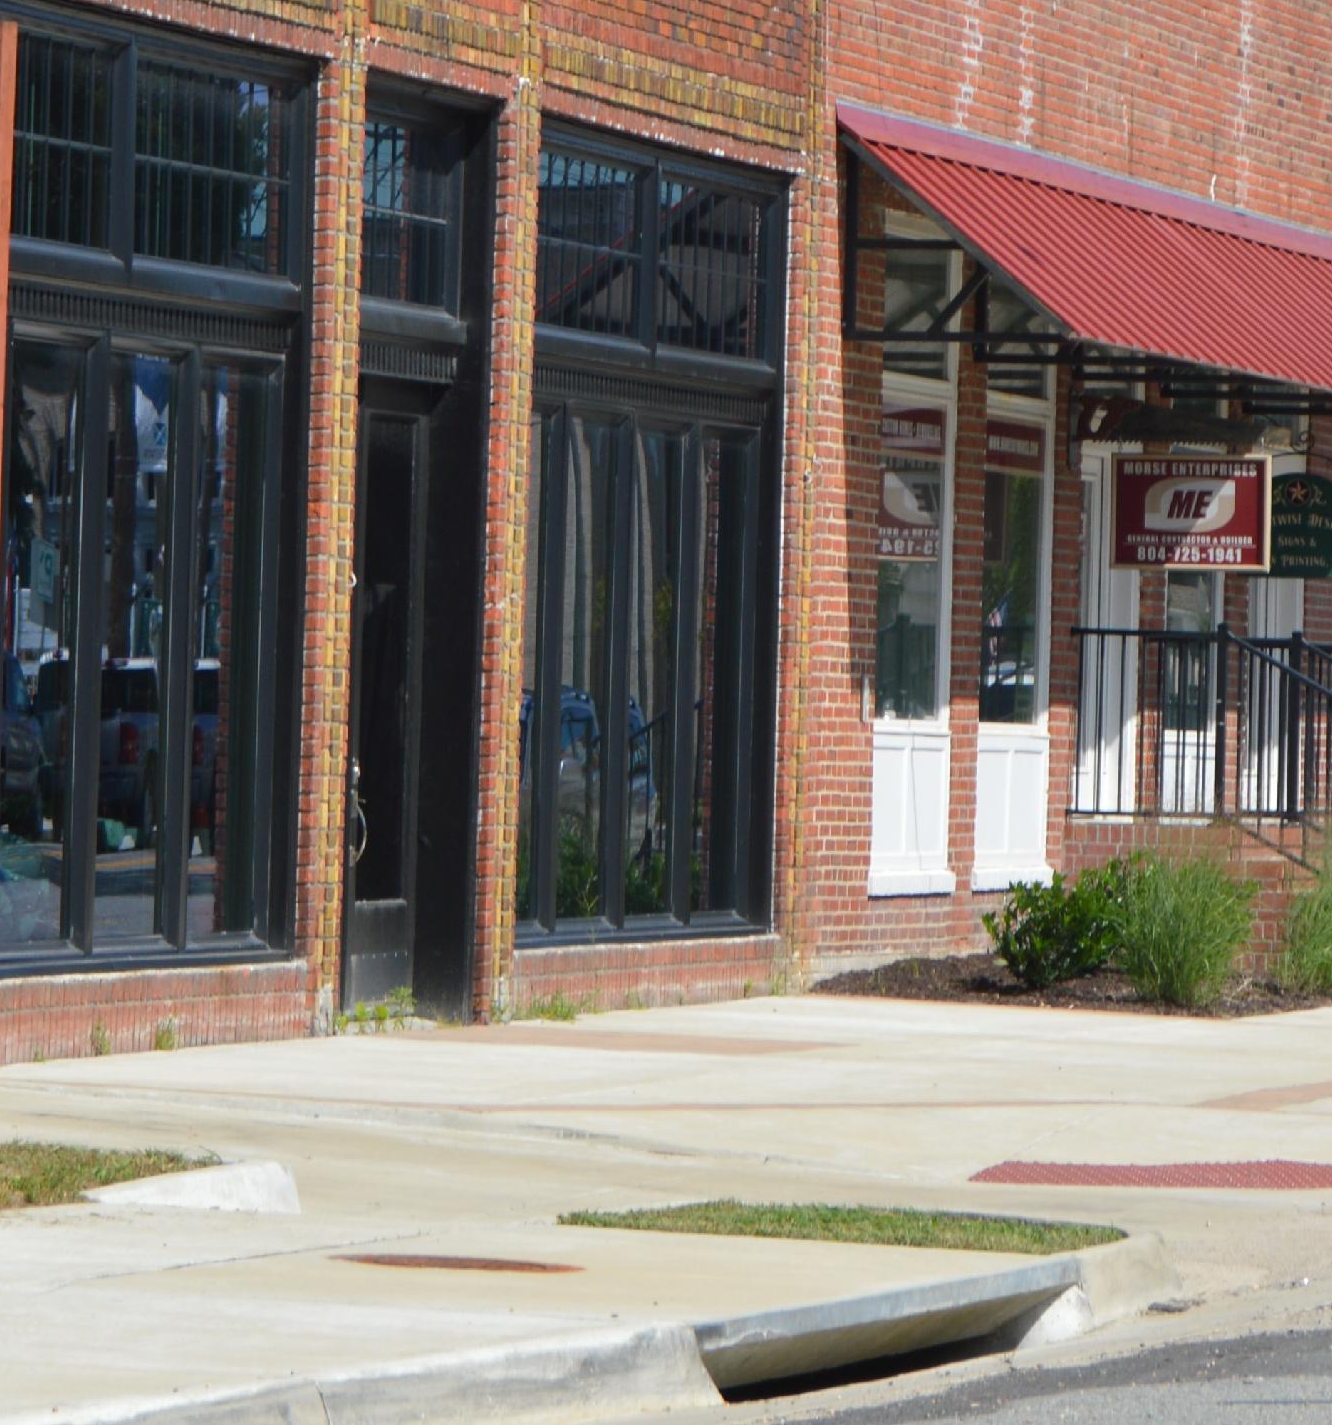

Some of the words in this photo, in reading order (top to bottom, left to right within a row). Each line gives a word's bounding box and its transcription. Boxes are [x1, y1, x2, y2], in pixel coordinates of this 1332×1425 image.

[1123, 462, 1166, 476] MORSE
[1171, 462, 1257, 477] ENTERPRISES
[1167, 489, 1213, 520] ME
[1161, 534, 1211, 545] CONTRACTOR
[1220, 536, 1253, 545] BUILDER
[1137, 546, 1242, 563] 804-725-1941
